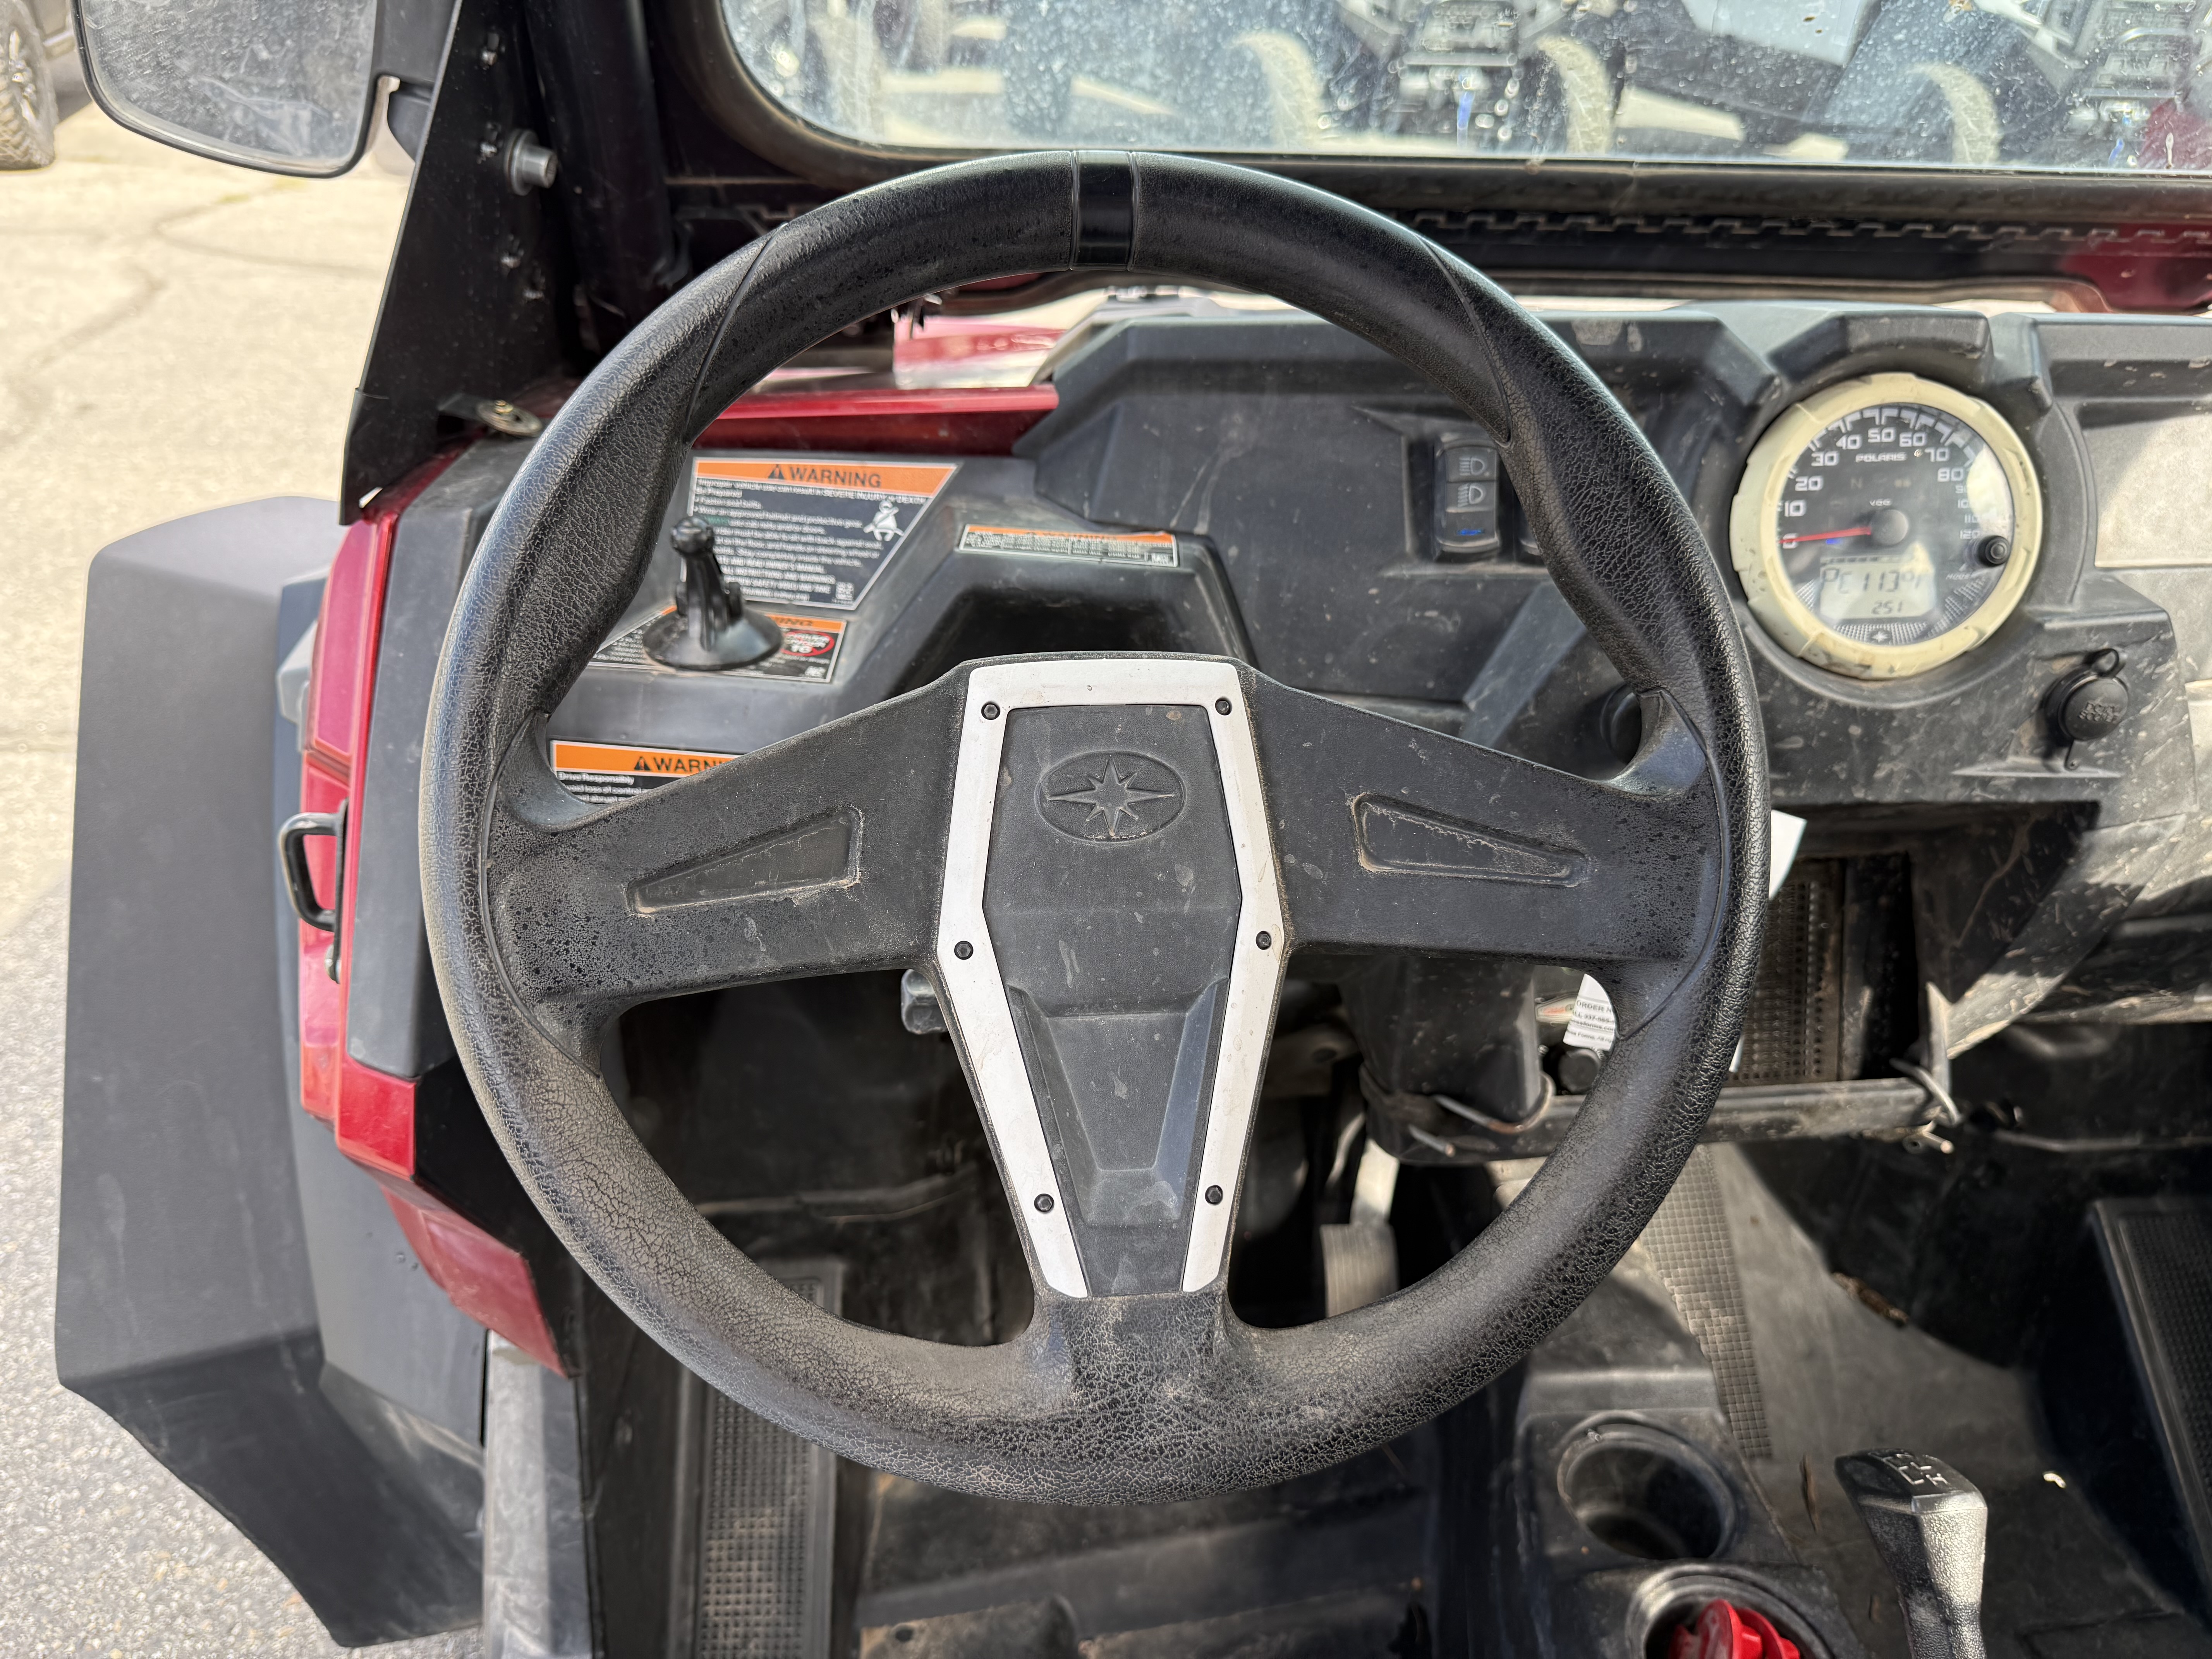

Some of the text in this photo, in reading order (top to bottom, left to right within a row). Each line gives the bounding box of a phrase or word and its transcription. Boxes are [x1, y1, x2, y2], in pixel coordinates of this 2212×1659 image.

[1836, 435, 1862, 449] 40
[1868, 428, 1896, 442] 50
[1899, 431, 1927, 447] 60
[1811, 451, 1839, 466] 30
[1855, 452, 1907, 462] POLARIS
[1925, 447, 1949, 462] 70
[790, 466, 881, 488] WARNING
[1937, 467, 1964, 482] 80
[1795, 476, 1823, 491] 20
[1784, 500, 1806, 517] 10
[1782, 533, 1799, 549] 0
[1577, 1000, 1604, 1012] ORDER
